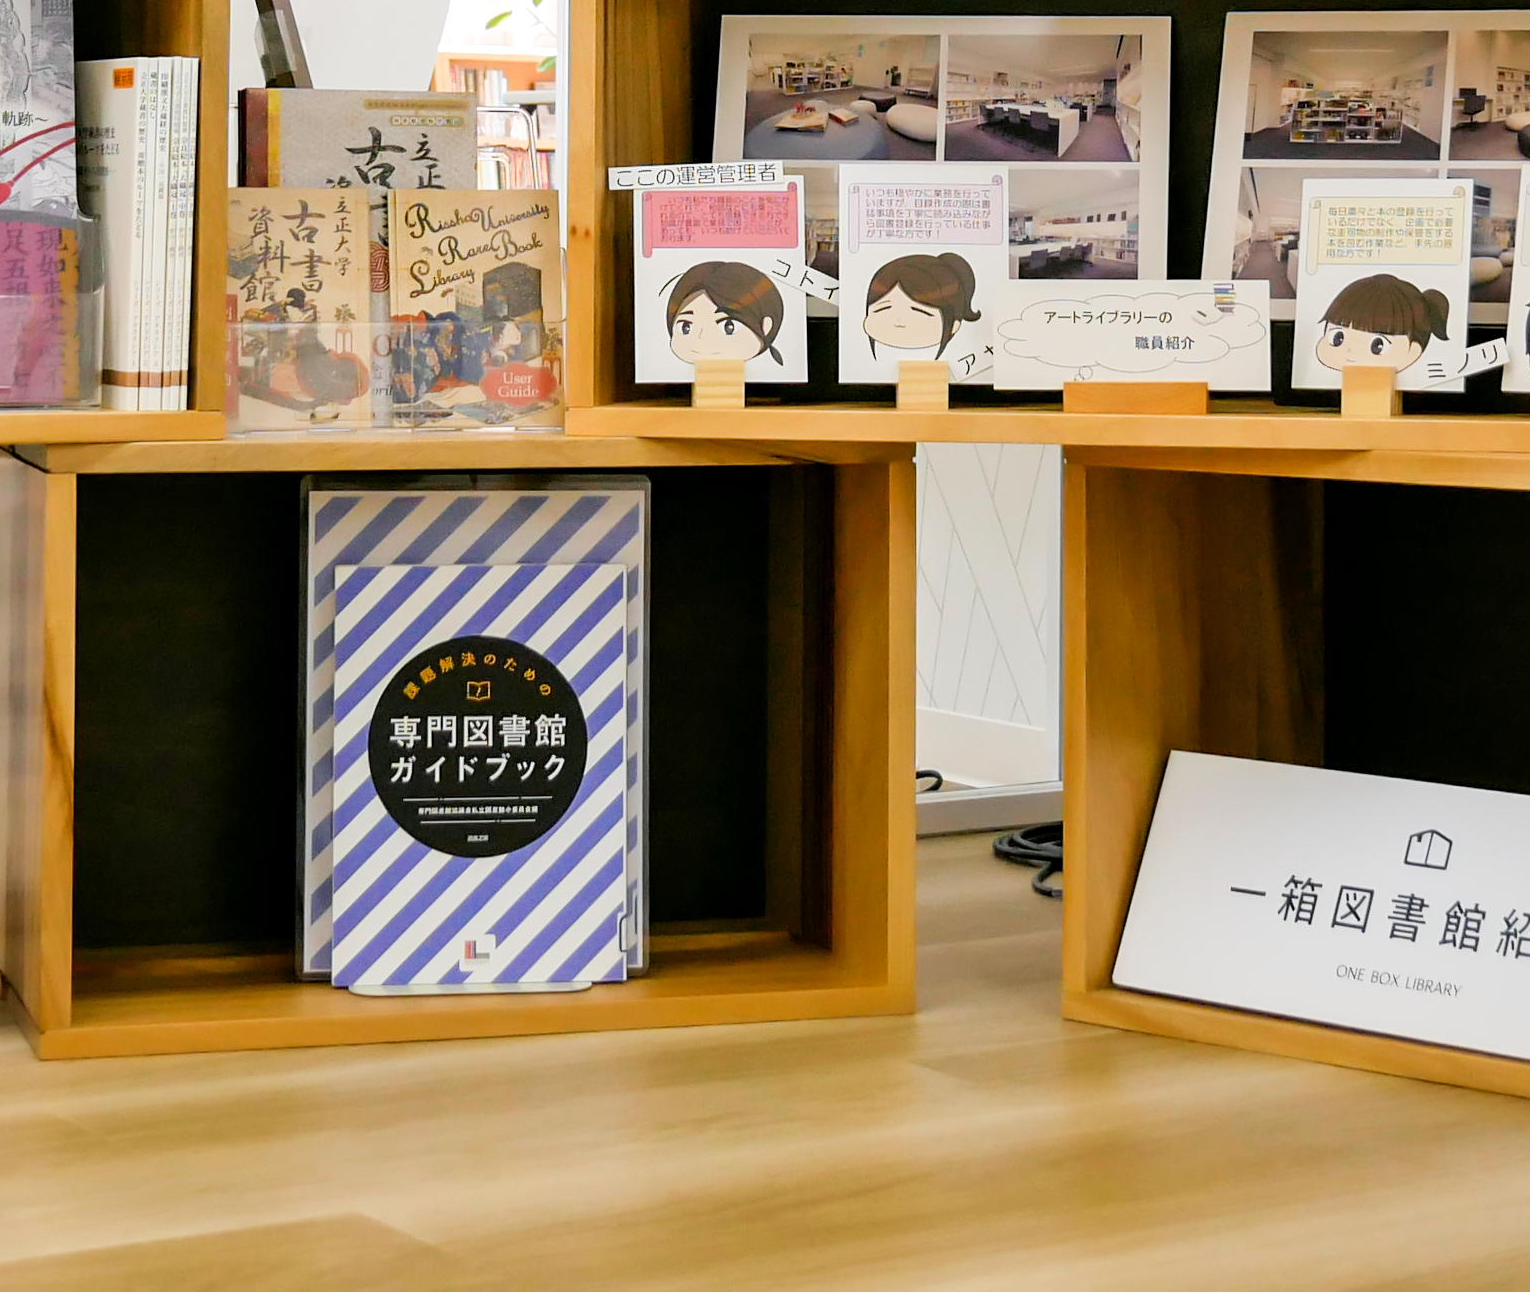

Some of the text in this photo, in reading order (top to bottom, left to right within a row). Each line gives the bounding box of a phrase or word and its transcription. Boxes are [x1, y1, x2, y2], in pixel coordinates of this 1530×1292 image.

[616, 163, 777, 188] ここの運営管理者
[865, 189, 991, 198] いつも穏やかに業務を行って
[333, 196, 352, 276] 立正大学
[405, 202, 550, 240] Rissho University
[239, 207, 291, 304] 資料館
[282, 199, 331, 293] 古書
[437, 229, 544, 266] Rare Book
[409, 259, 476, 299] Library
[1043, 310, 1173, 325] アートライブラリーの
[1135, 335, 1195, 350] 職員紹介
[502, 372, 533, 385] User
[1426, 343, 1499, 381] ミノリ
[497, 385, 540, 398] Guide
[389, 714, 567, 749] 専門図書館
[389, 753, 566, 783] ガイドブック
[1335, 964, 1464, 998] ONE BOX LIBRARY
